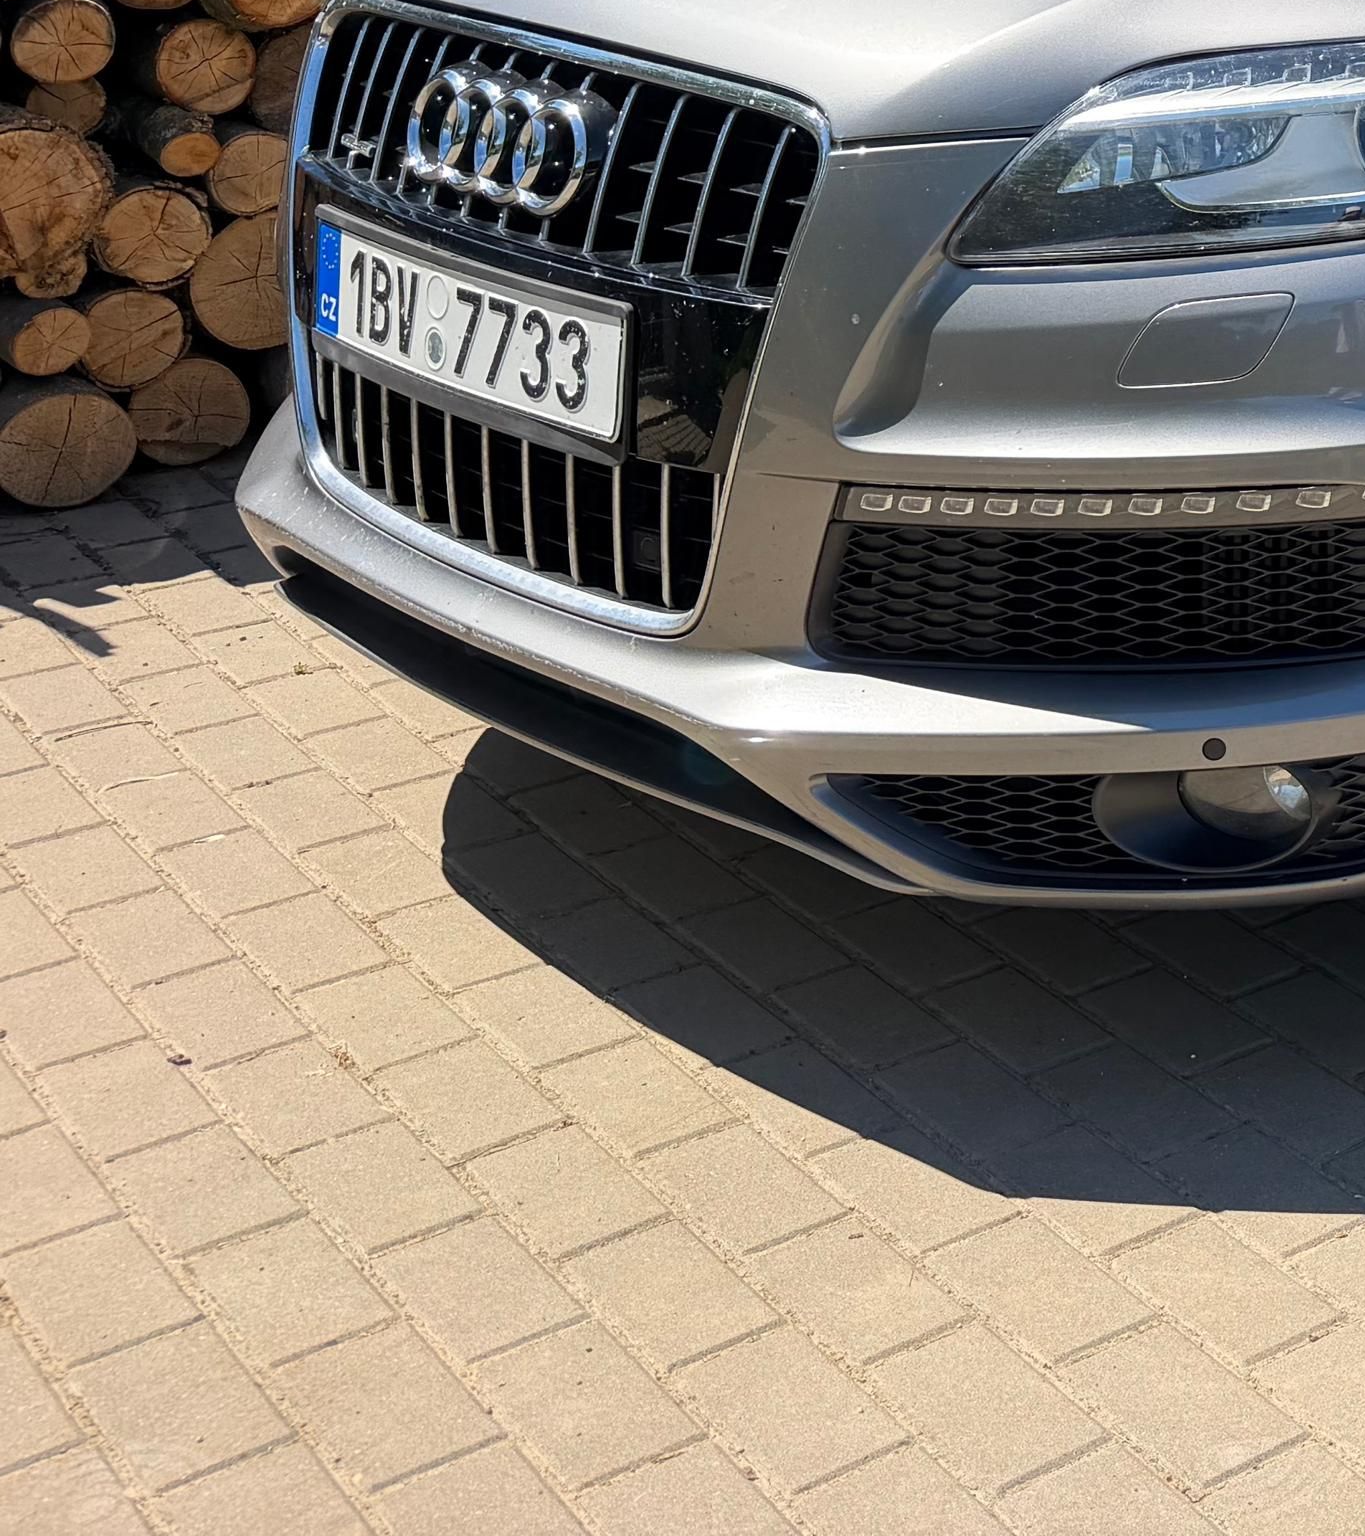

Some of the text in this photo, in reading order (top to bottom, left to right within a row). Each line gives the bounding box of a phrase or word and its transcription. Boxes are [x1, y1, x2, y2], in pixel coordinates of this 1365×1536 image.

[321, 293, 337, 321] CZ
[350, 250, 590, 412] 1BV 7733
